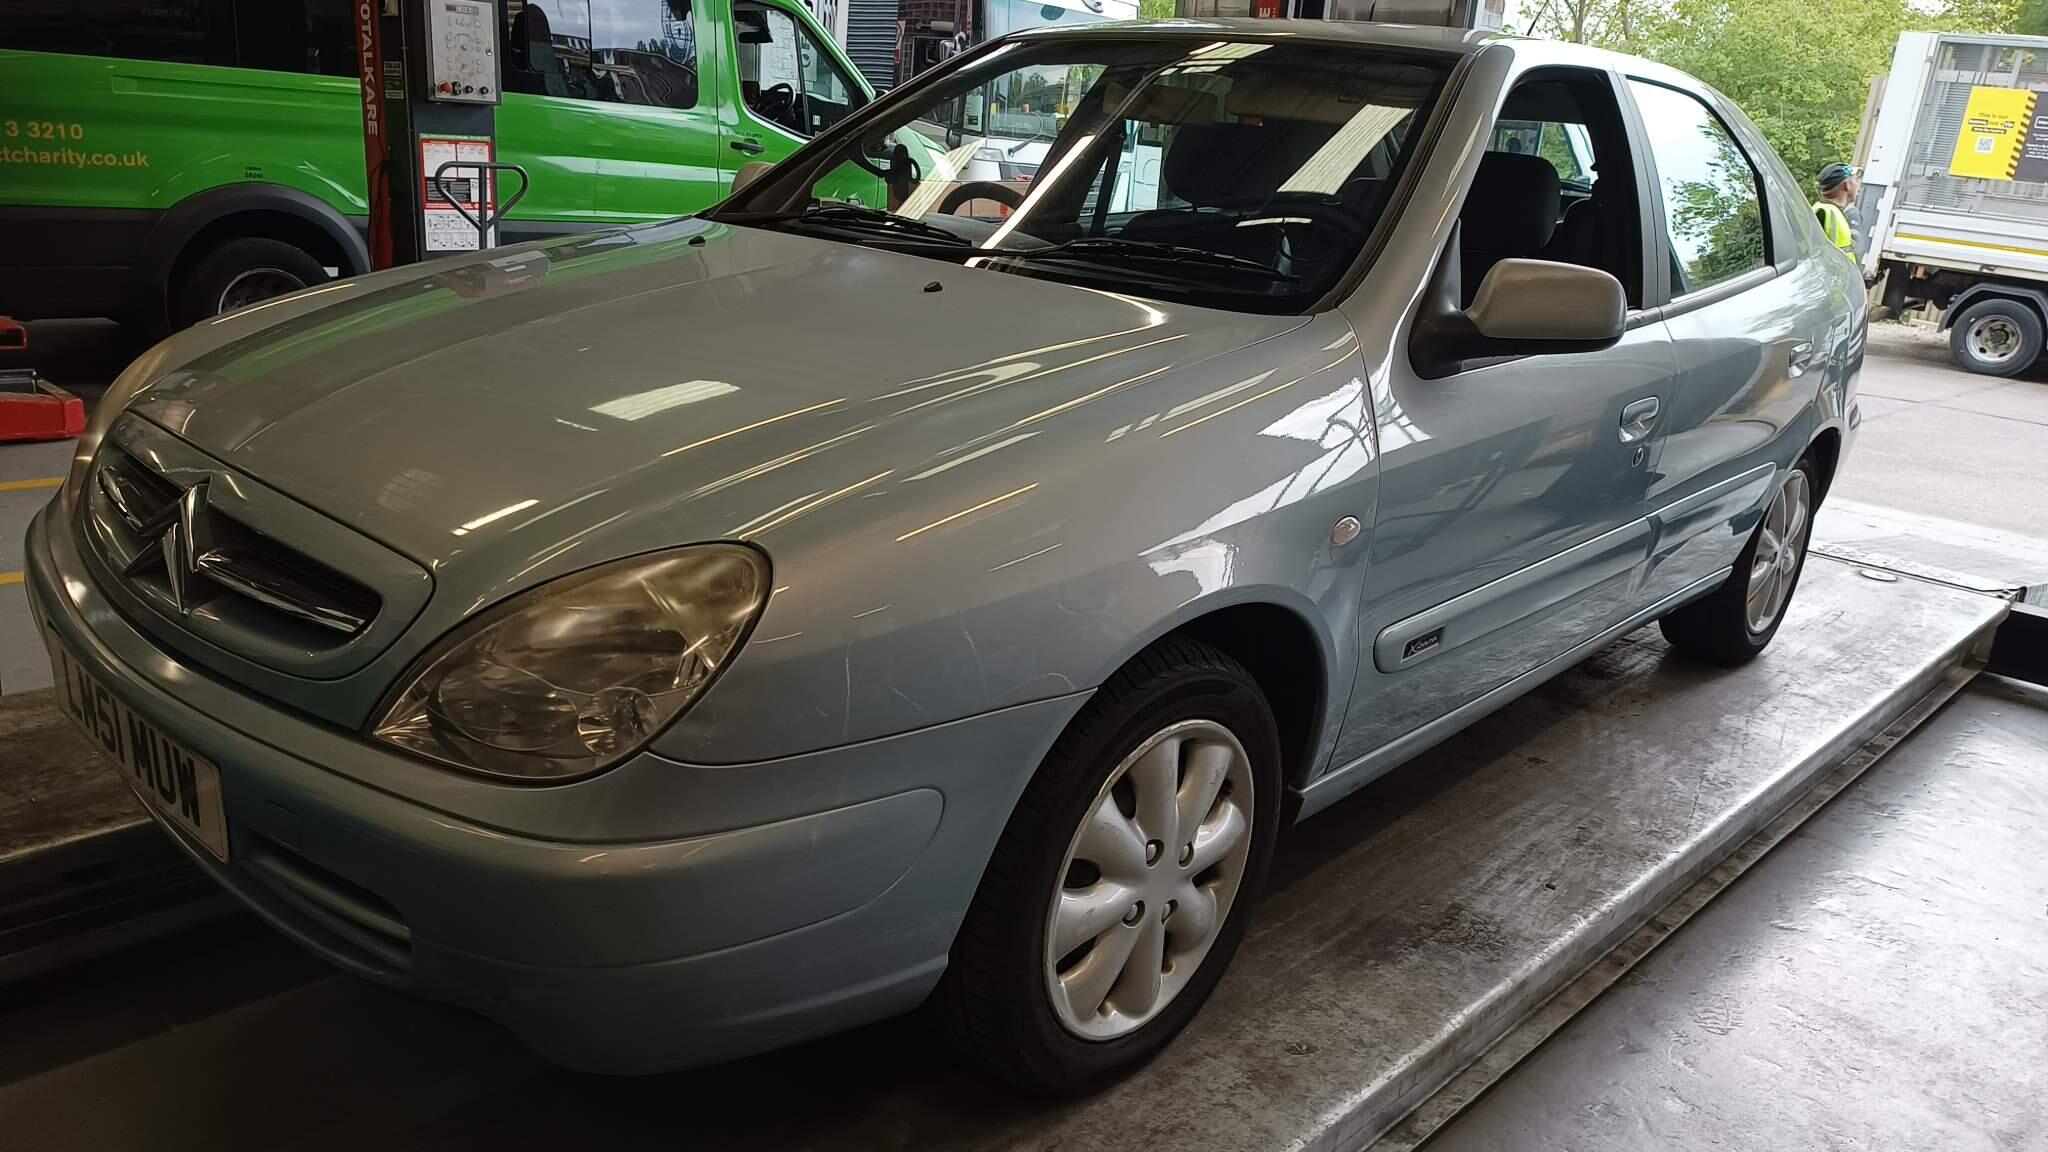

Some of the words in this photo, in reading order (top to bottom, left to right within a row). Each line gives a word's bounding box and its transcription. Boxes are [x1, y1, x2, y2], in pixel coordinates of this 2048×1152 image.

[360, 0, 378, 136] OTALKARE
[0, 146, 149, 168] tcharity.co.uk
[27, 121, 84, 140] 3210
[127, 709, 201, 828] MUW
